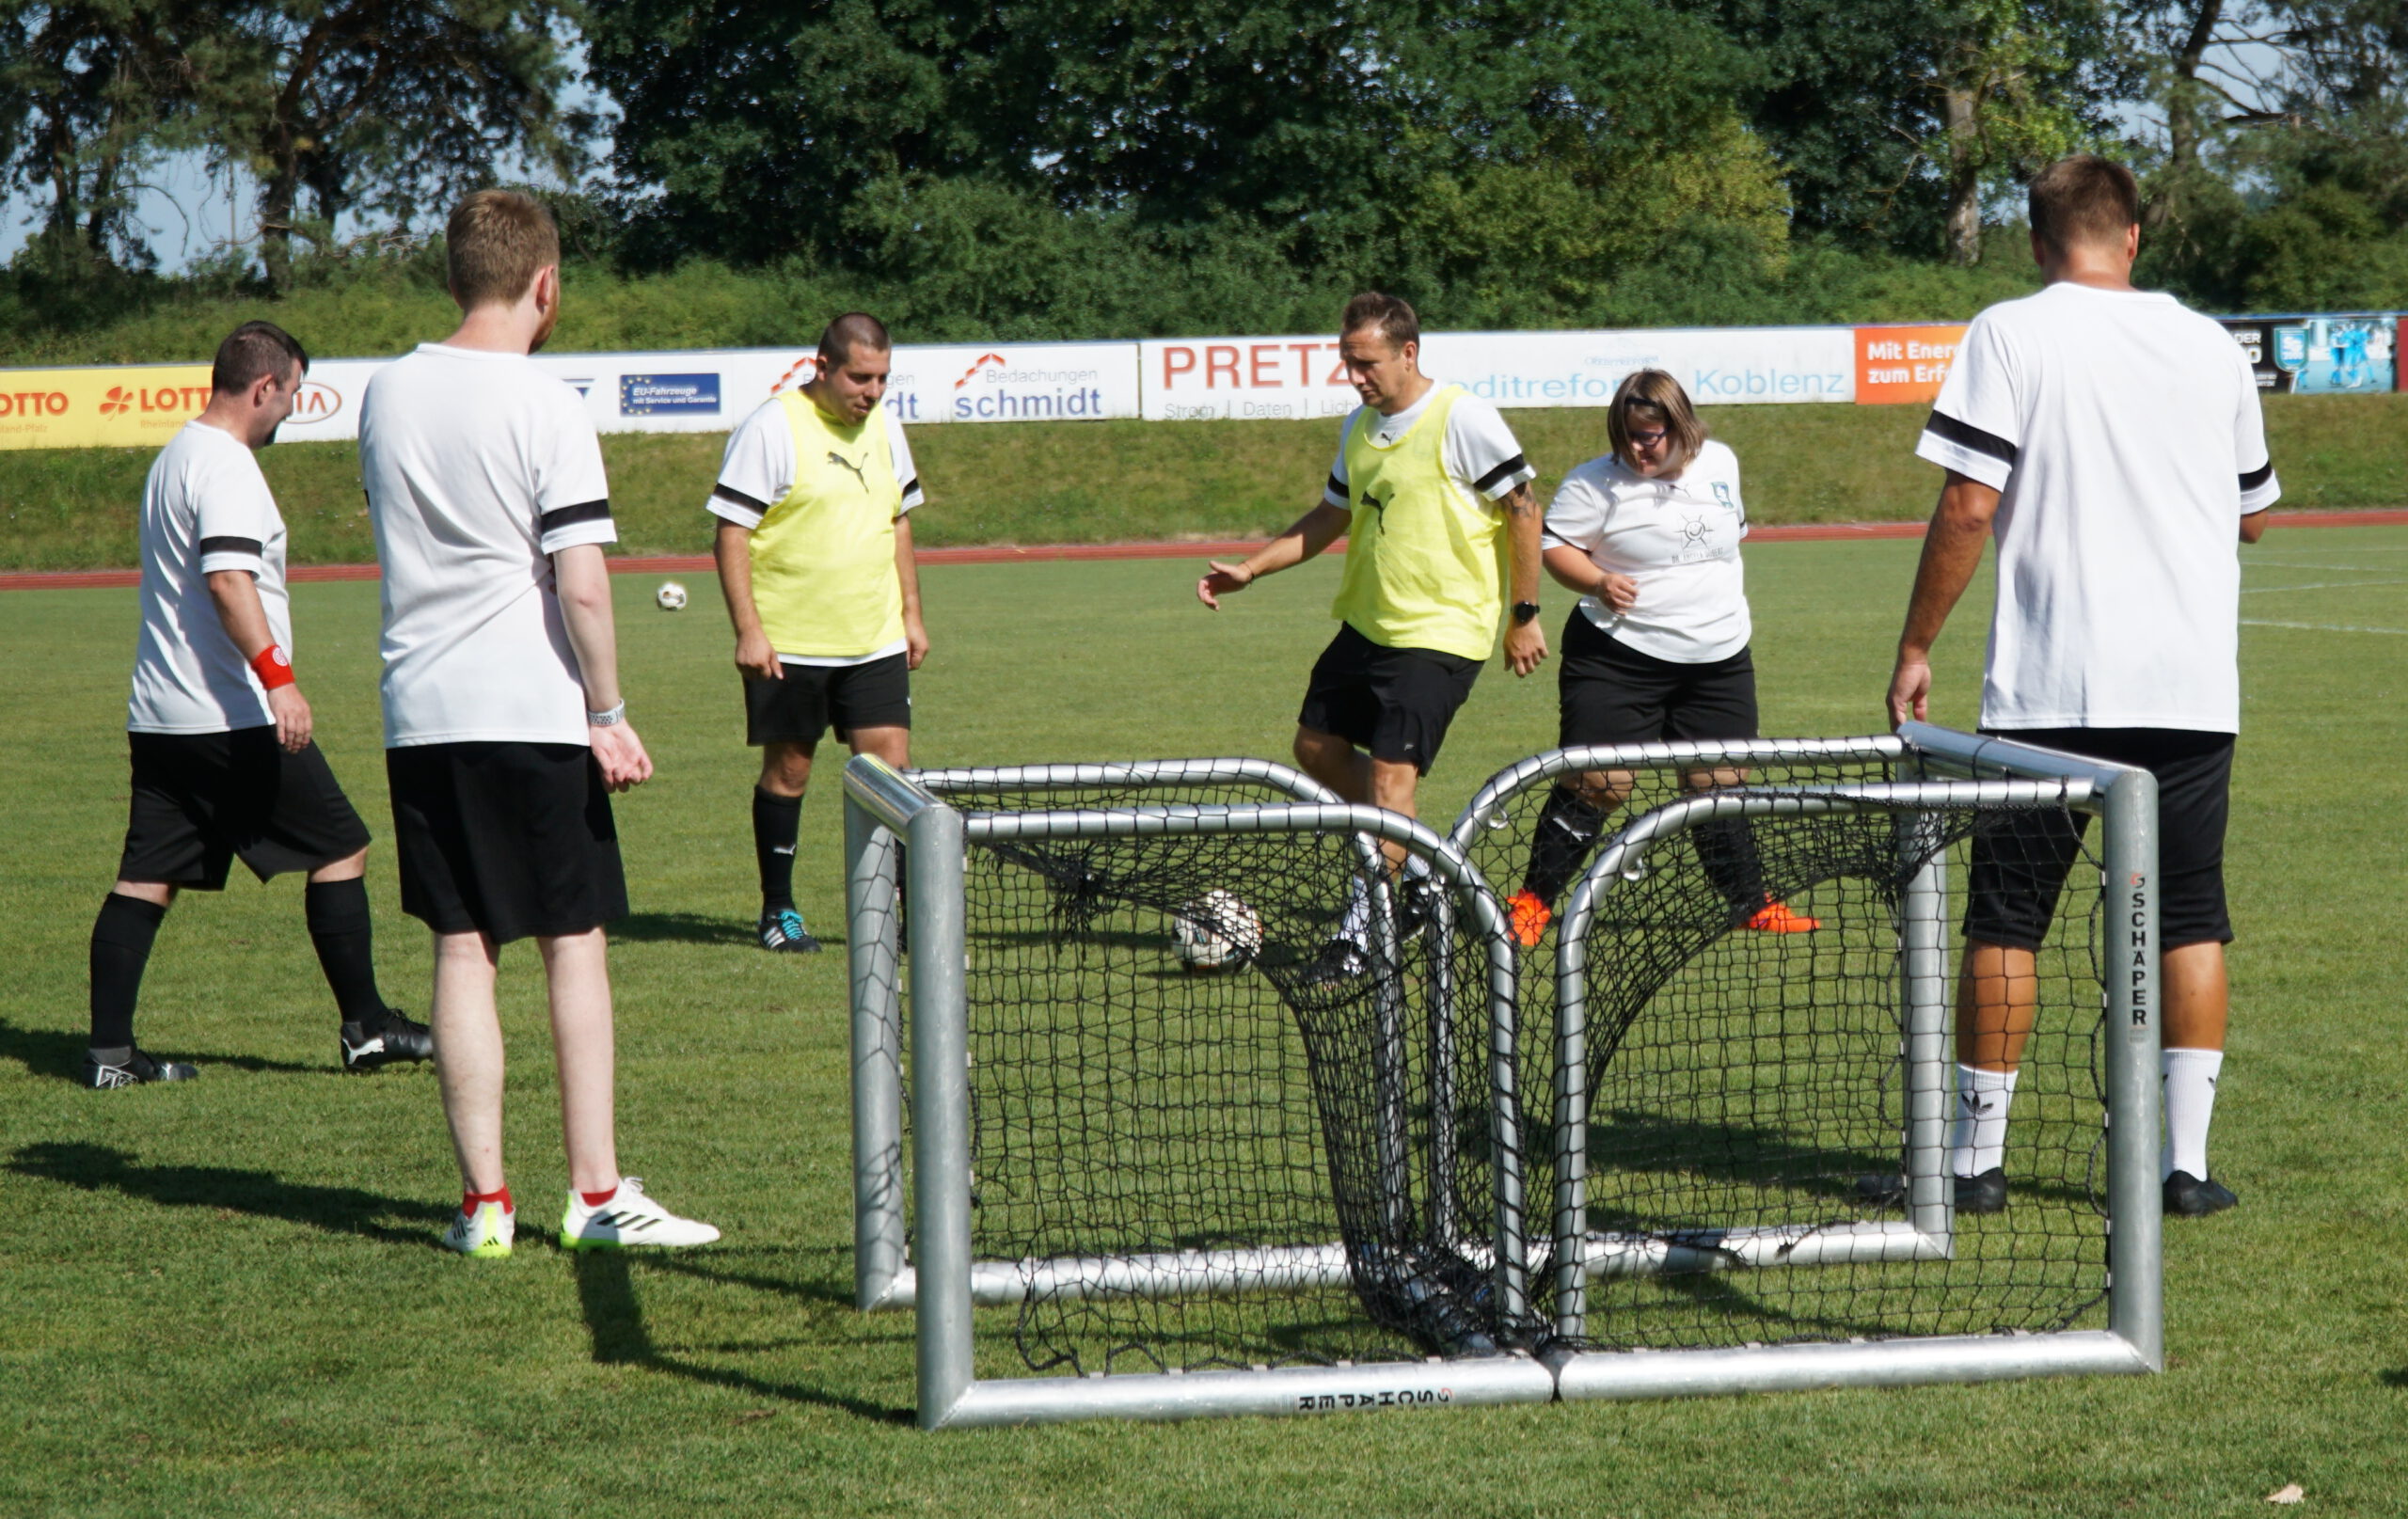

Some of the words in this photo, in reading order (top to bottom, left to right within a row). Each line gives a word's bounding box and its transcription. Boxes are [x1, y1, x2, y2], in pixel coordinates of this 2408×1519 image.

[1868, 341, 1903, 360] Mit
[1908, 341, 1956, 359] Ener
[986, 368, 1098, 384] Bedachungen
[1695, 369, 1846, 395] Koblenz
[1868, 369, 1909, 383] zum
[1915, 365, 1947, 383] Erf
[140, 387, 212, 412] LOTT
[633, 387, 697, 397] EU-Fahrzeuge
[689, 395, 716, 403] Garantie
[0, 392, 69, 418] OTTO
[296, 391, 327, 414] IA
[955, 387, 1102, 419] schmidt
[1165, 403, 1215, 419] Strom
[1244, 402, 1291, 416] Daten
